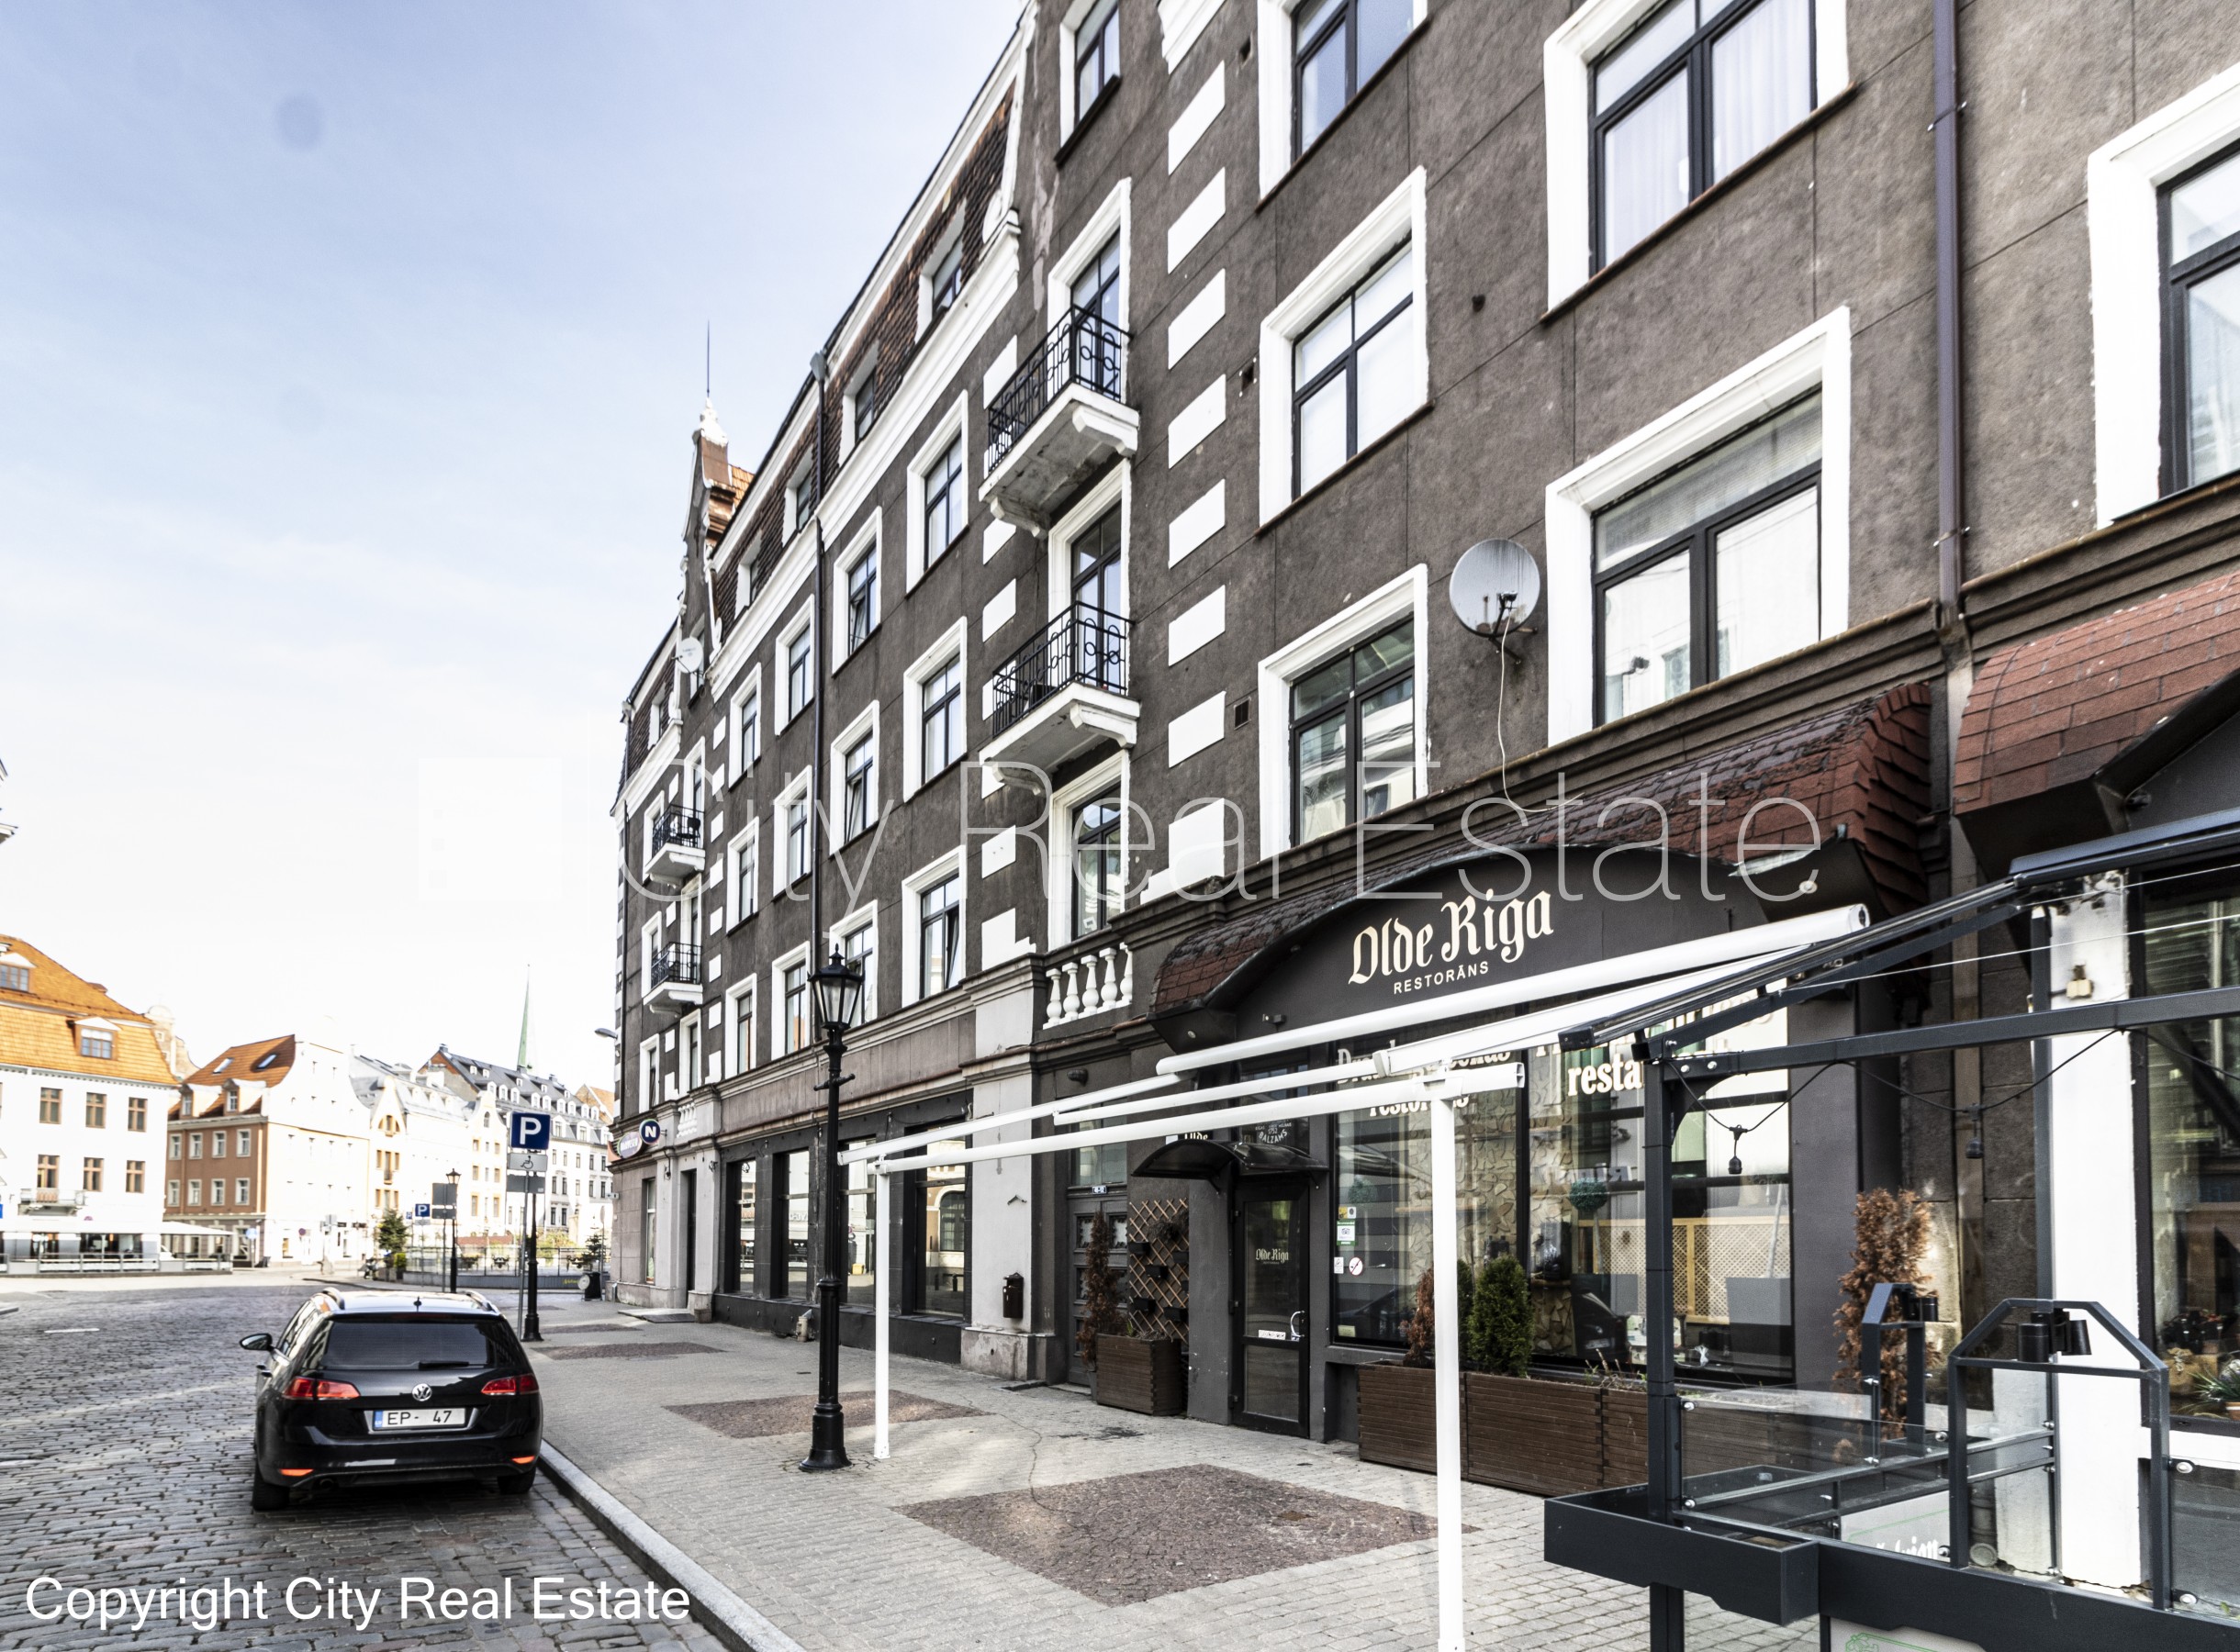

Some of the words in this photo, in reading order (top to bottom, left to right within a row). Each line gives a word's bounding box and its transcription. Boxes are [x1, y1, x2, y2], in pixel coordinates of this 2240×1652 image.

[1348, 918, 1434, 985] Olde
[1440, 888, 1554, 964] Riga
[1394, 961, 1490, 995] RESTORĀNS
[520, 1116, 542, 1145] P
[644, 1125, 657, 1138] N
[1259, 1129, 1288, 1144] BALZAMS
[418, 1204, 428, 1216] P
[432, 1410, 453, 1423] 47
